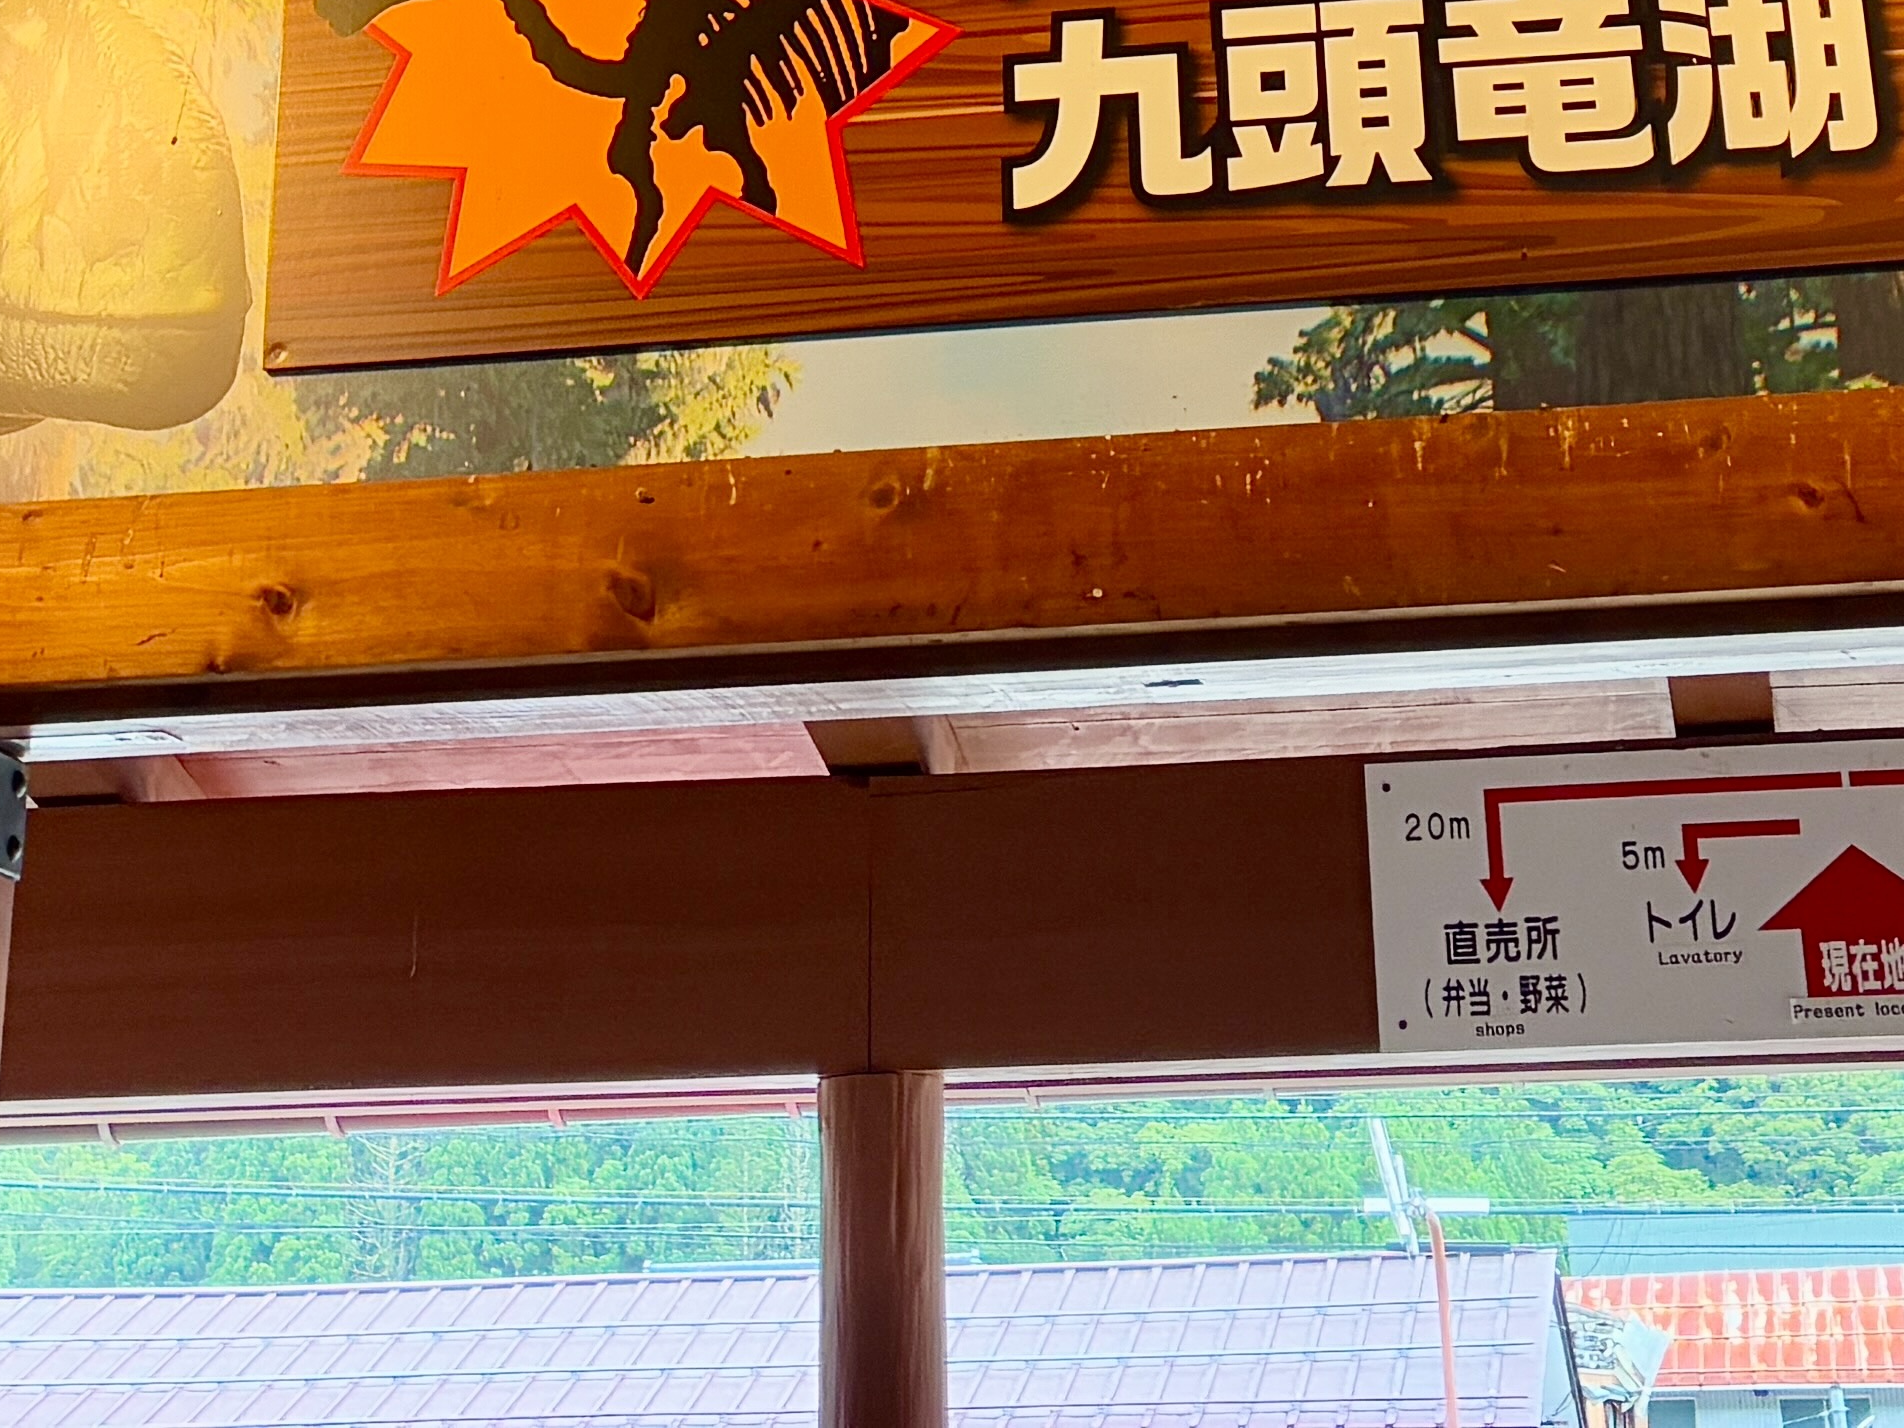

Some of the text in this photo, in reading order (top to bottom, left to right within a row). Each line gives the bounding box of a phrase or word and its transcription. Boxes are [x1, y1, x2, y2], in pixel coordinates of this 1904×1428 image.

[1404, 812, 1471, 842] 20m
[1621, 840, 1666, 870] 5m
[1646, 899, 1737, 944] トイレ
[1443, 915, 1561, 966] 直売所
[1658, 948, 1744, 966] Lavatory
[1793, 1002, 1865, 1020] Present
[1475, 1021, 1526, 1038] shops
